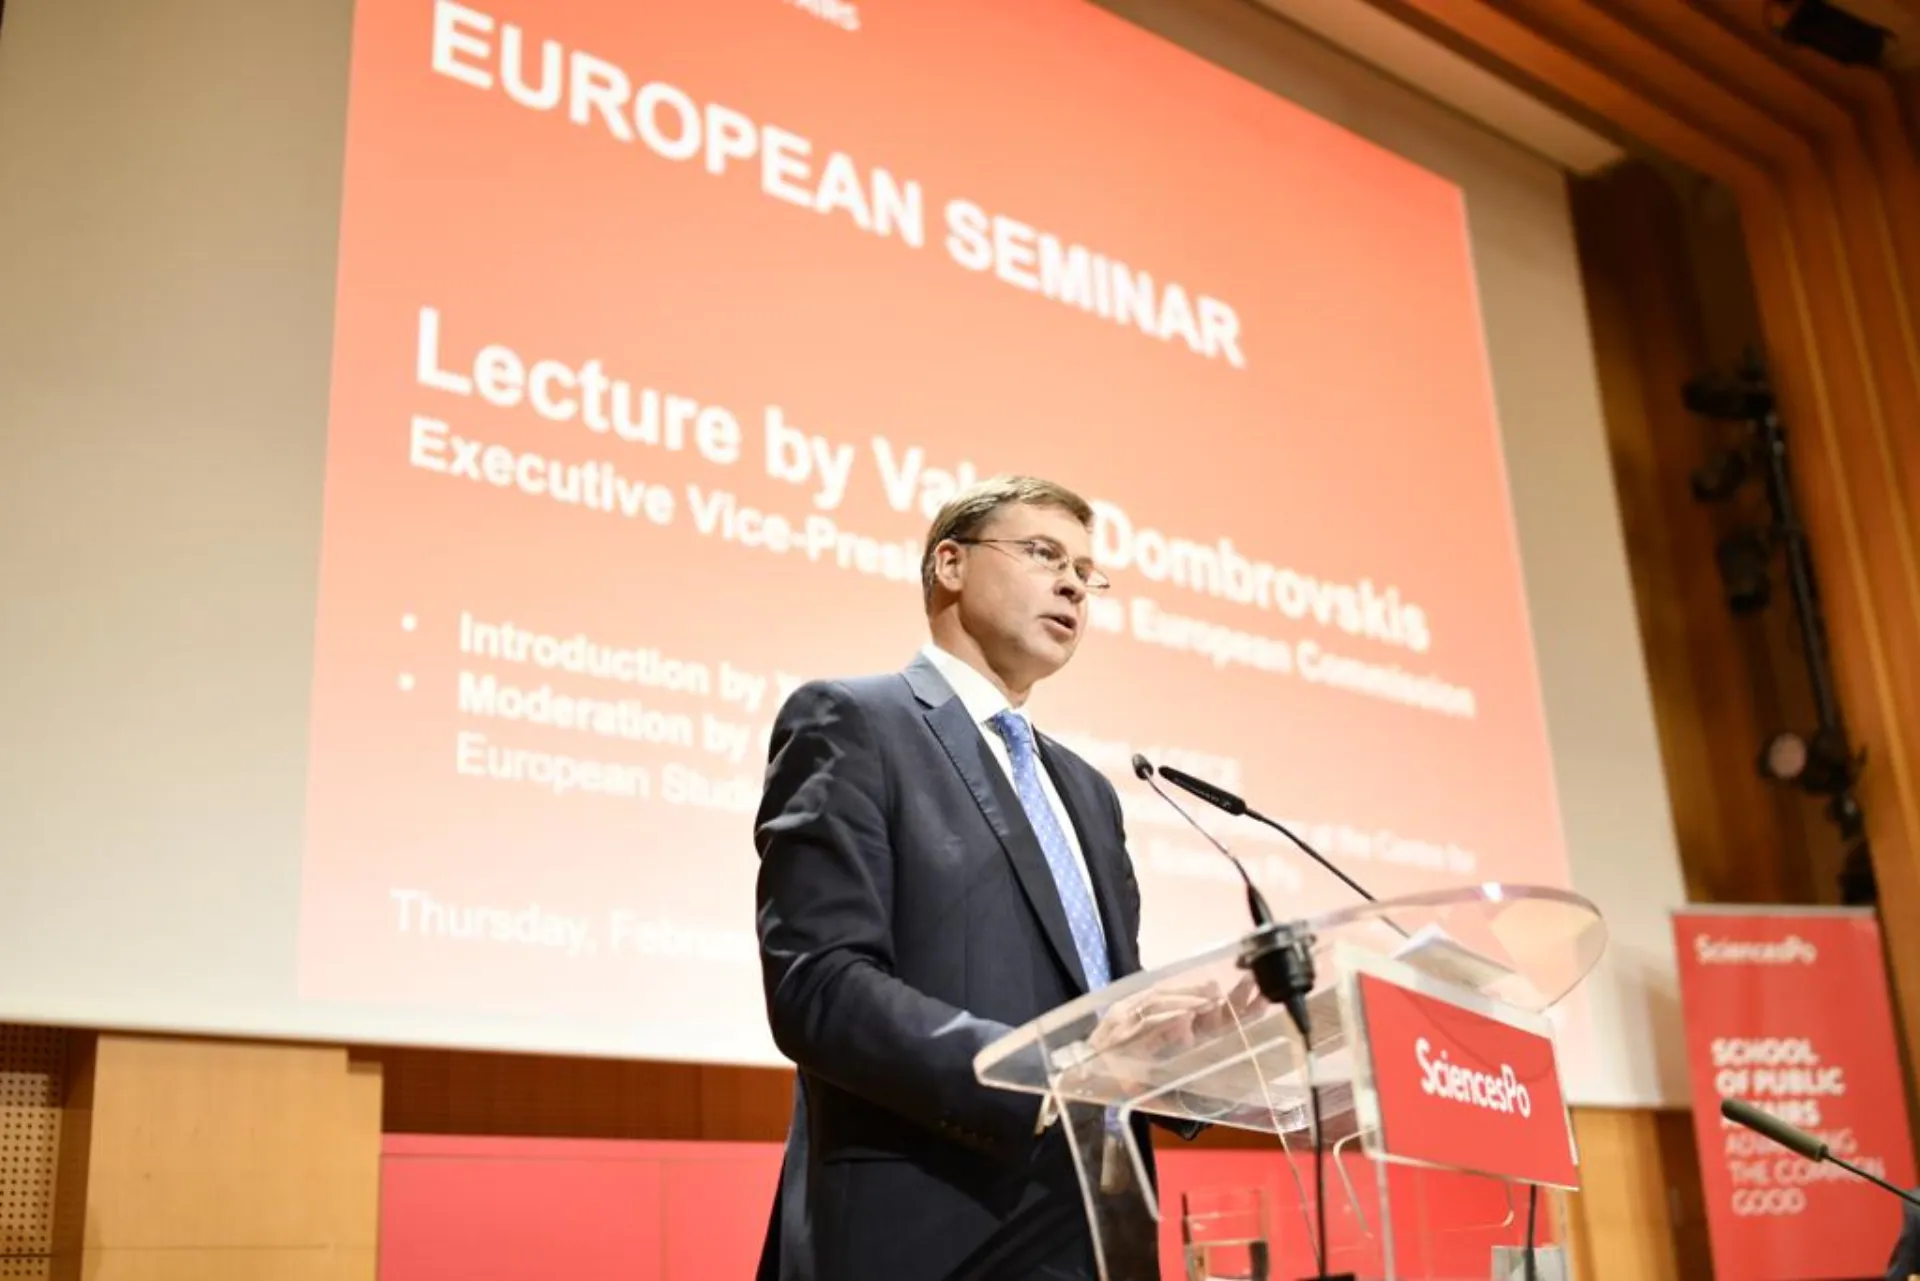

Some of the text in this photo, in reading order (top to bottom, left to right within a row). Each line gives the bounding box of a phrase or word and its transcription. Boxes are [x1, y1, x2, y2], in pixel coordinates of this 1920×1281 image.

[432, 0, 1246, 368] EUROPEAN SEMINAR
[408, 414, 675, 525] Executive
[416, 306, 742, 464] Lecture
[764, 404, 855, 510] by
[1091, 499, 1431, 652] Dombrovskis
[460, 610, 709, 695] Introduction
[719, 660, 765, 712] by
[458, 670, 692, 747] Moderation
[703, 714, 749, 762] by
[456, 731, 650, 799] European
[390, 888, 598, 958] Thursday,
[1415, 1037, 1531, 1118] SciencesPo
[1711, 1037, 1818, 1067] SCHOOL
[1715, 1067, 1845, 1096] OF PUBLIC
[1731, 1187, 1807, 1216] GOOD
